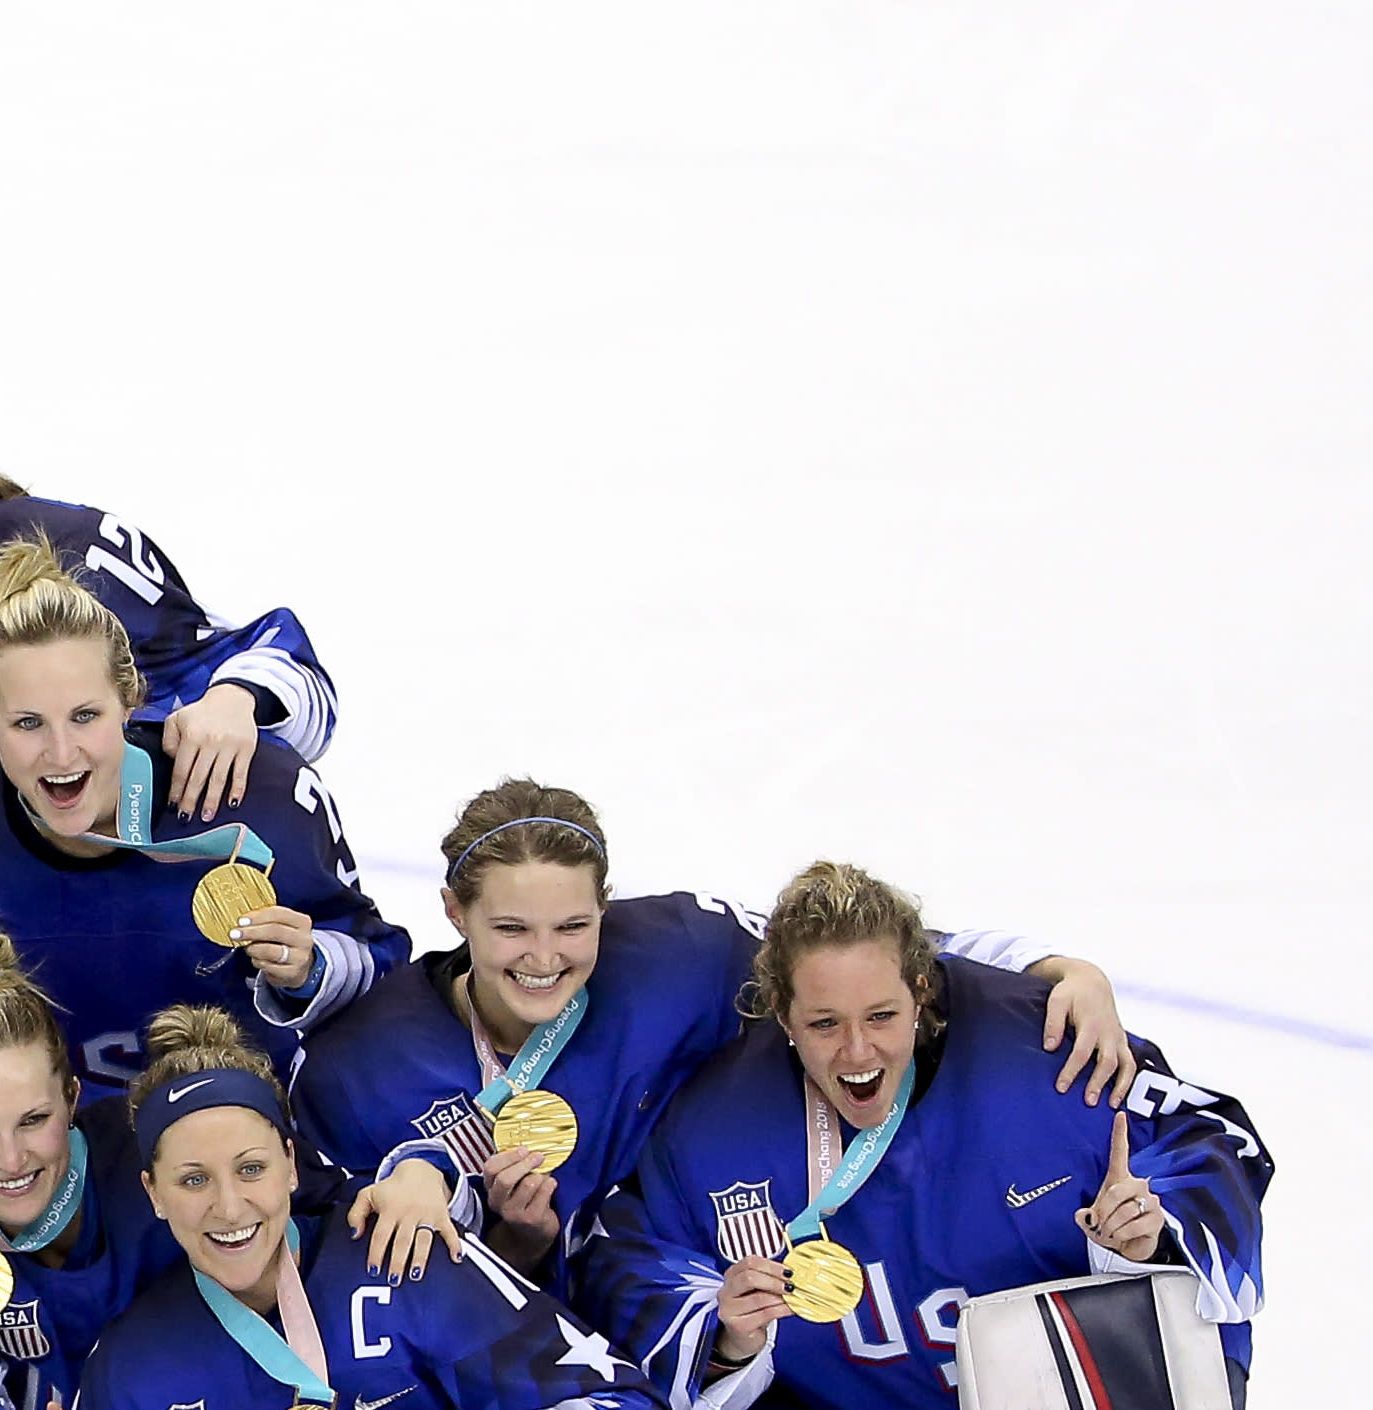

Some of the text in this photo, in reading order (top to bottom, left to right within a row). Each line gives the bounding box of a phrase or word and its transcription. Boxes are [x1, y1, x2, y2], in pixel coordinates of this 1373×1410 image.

[85, 513, 167, 606] 12
[128, 783, 144, 846] PyeongC
[424, 1103, 466, 1135] USA
[723, 1193, 764, 1215] USA
[350, 1285, 393, 1360] C
